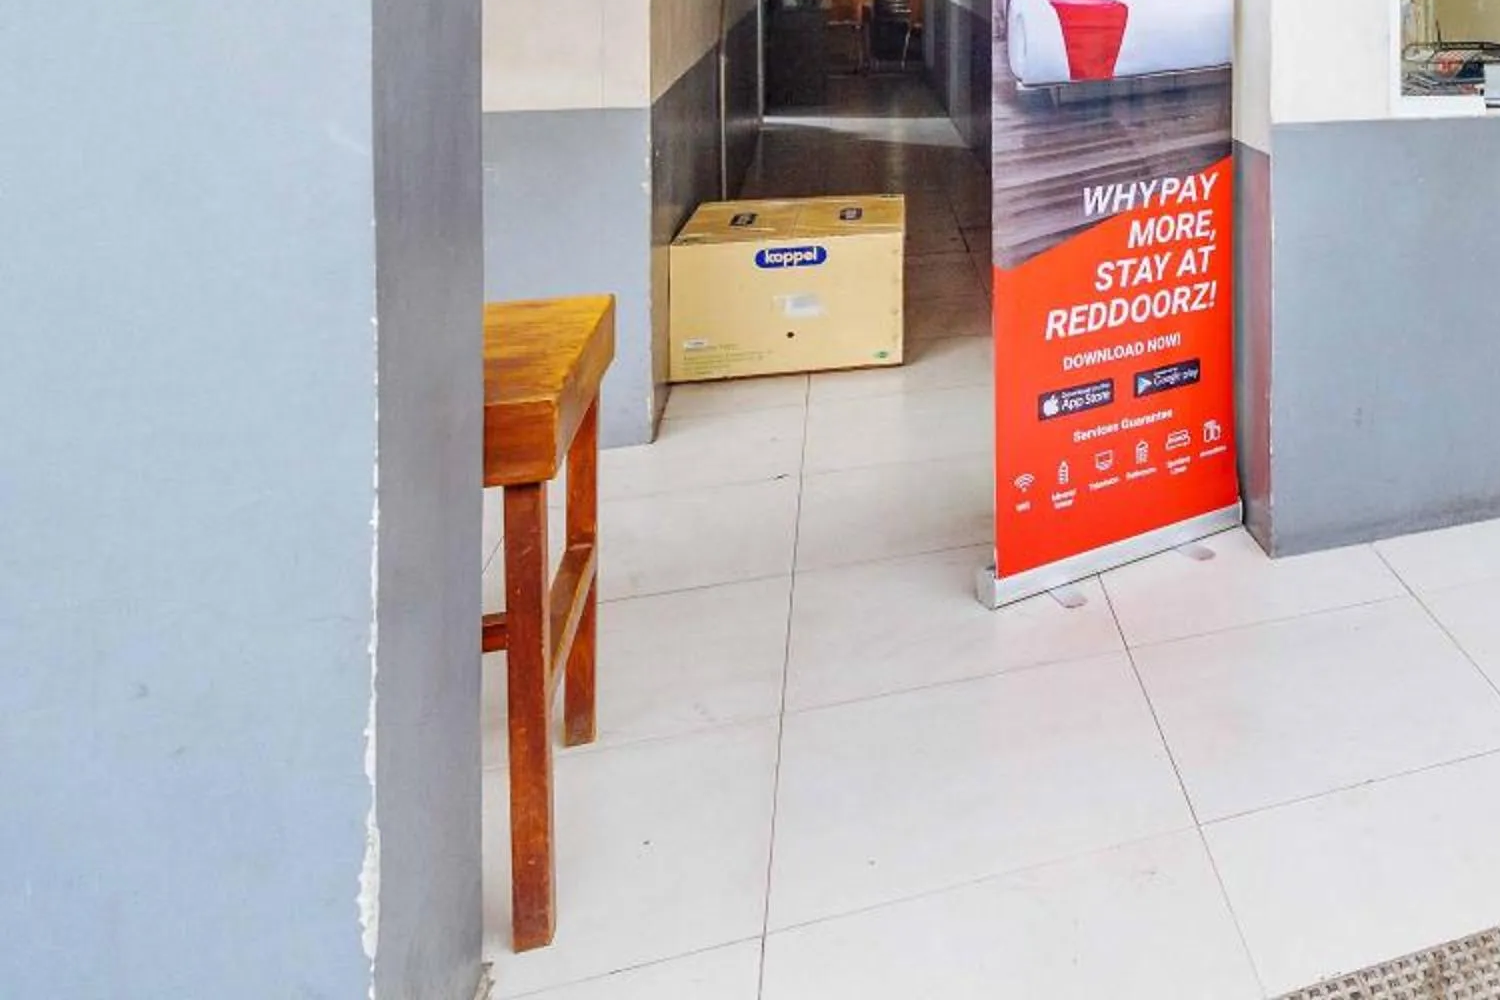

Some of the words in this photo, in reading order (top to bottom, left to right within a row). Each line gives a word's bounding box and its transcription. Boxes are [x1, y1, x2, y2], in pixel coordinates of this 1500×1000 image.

[1127, 209, 1216, 249] MORE,
[765, 247, 817, 268] koppel
[1095, 252, 1170, 292] STAY
[1176, 245, 1216, 276] AT
[1045, 280, 1217, 340] REDDOORZ!
[1063, 341, 1144, 370] DOWNLOAD
